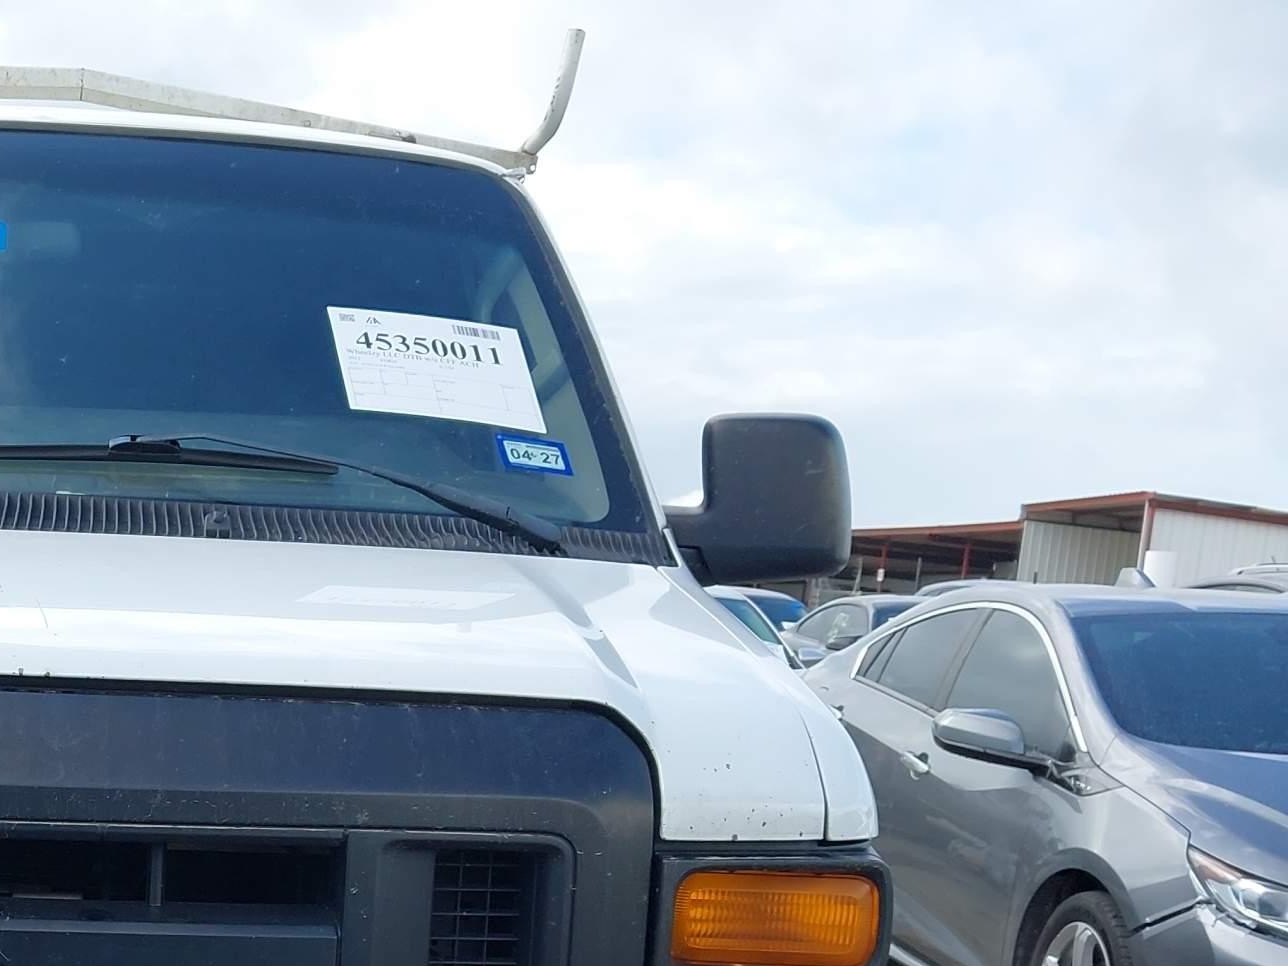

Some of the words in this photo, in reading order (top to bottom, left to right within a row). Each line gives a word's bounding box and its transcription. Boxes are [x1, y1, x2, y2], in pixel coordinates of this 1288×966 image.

[356, 331, 501, 365] 45350011
[510, 448, 532, 461] 04
[540, 452, 560, 464] 27
